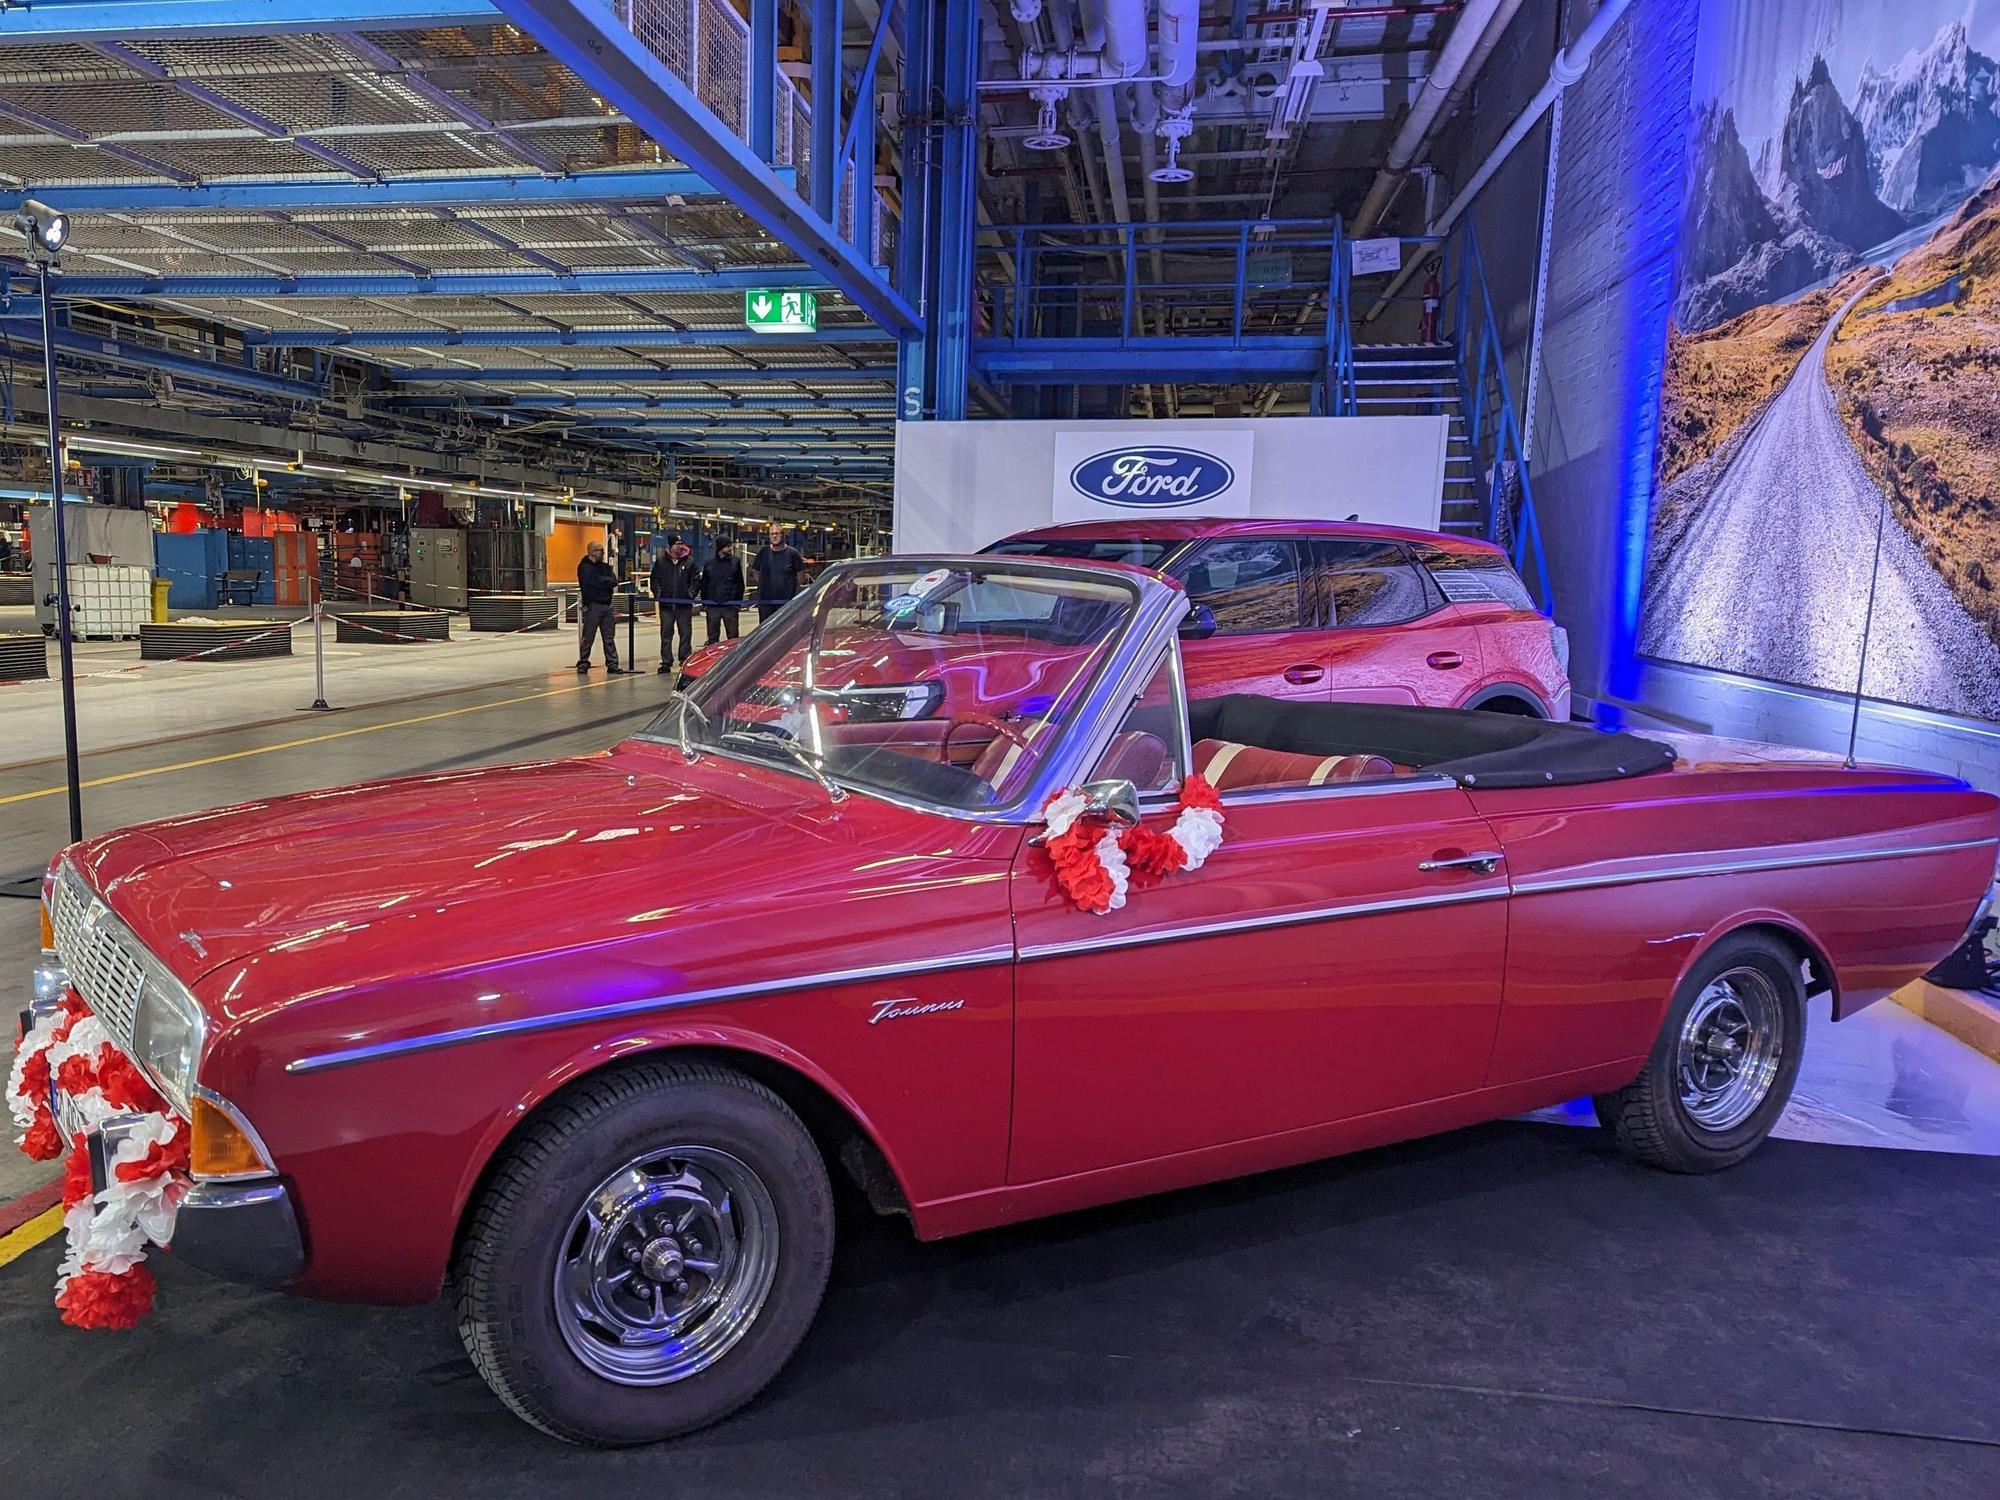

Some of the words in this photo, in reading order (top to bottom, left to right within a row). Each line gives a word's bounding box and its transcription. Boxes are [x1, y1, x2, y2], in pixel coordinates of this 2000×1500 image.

[904, 386, 921, 417] S
[1102, 455, 1202, 496] Ford
[868, 997, 965, 1024] Taunus
